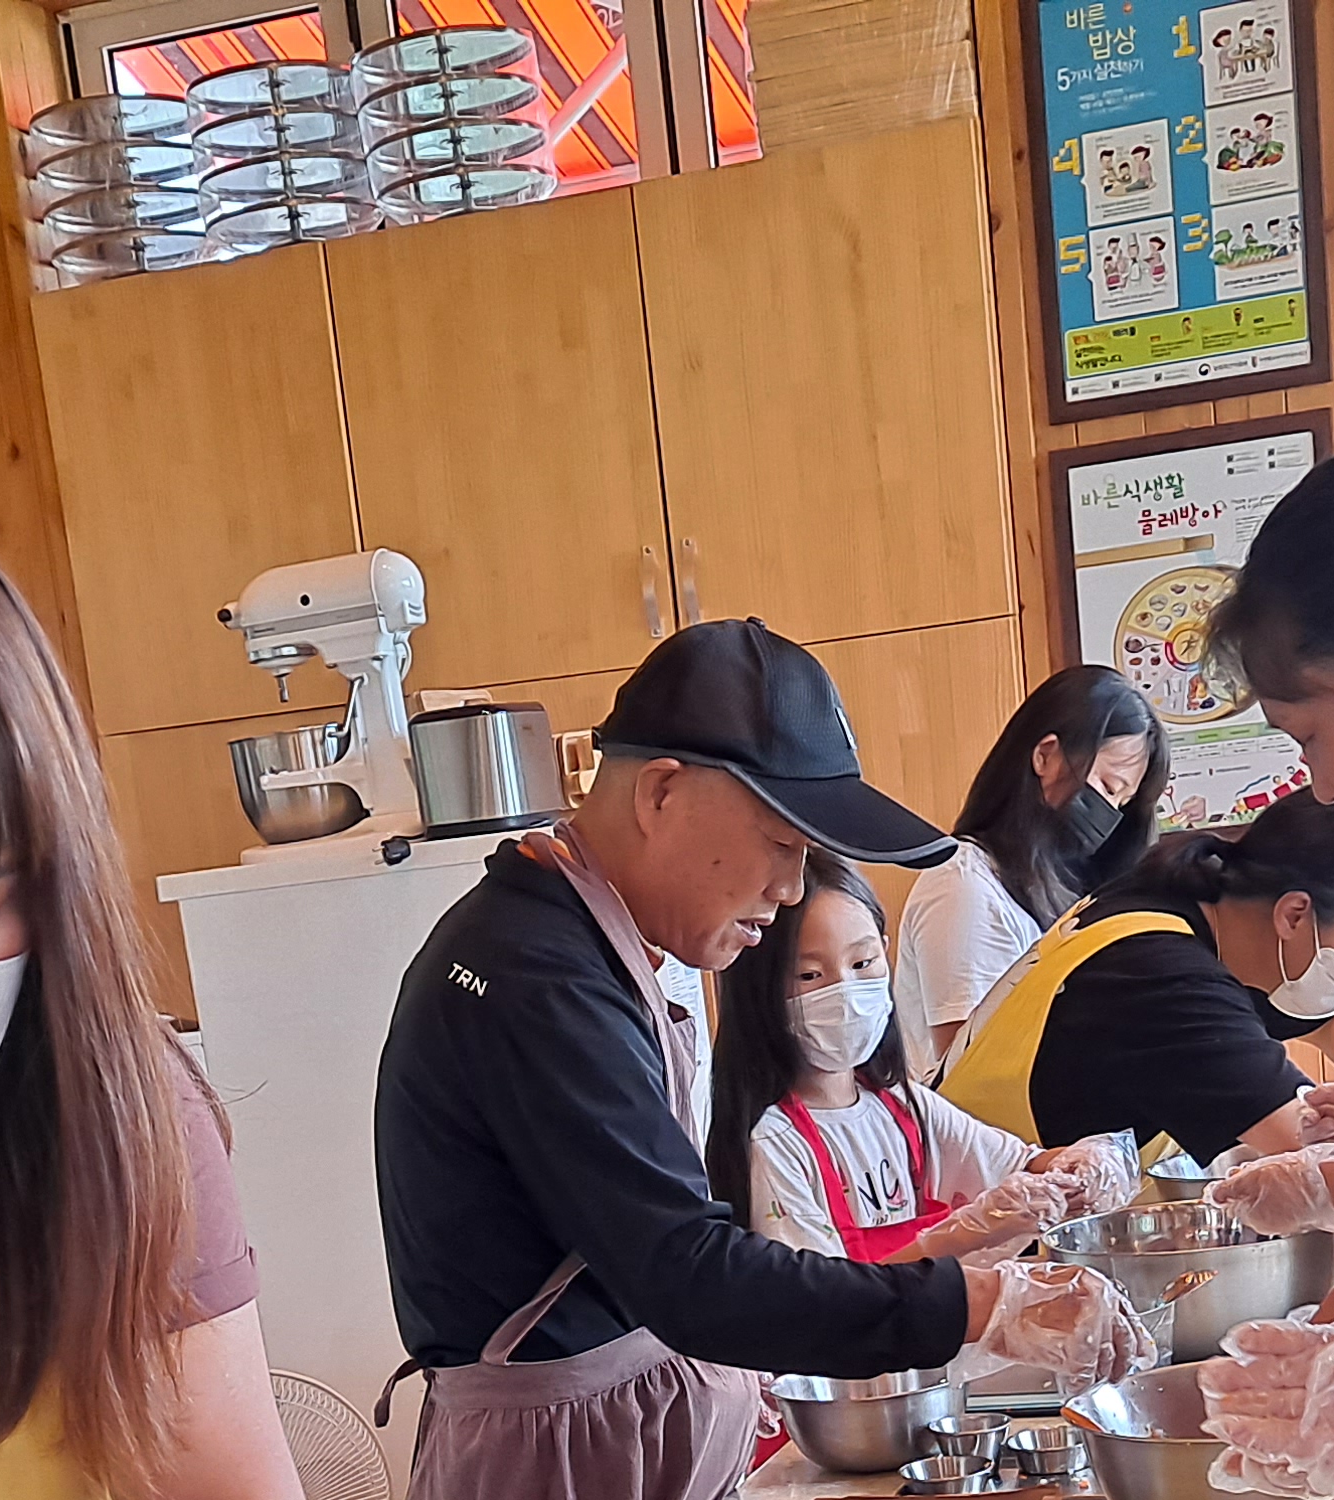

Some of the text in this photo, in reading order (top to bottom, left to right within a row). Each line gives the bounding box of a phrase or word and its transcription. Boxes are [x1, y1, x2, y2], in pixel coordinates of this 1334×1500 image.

[1066, 3, 1107, 30] 바른
[1088, 25, 1136, 60] 밥상
[1172, 15, 1197, 58] 1
[1057, 58, 1144, 91] 5가지 실천하기
[1175, 115, 1204, 155] 2
[1052, 138, 1081, 175] 4
[1181, 213, 1210, 252] 3
[1059, 235, 1087, 274] 5
[447, 962, 488, 997] TRN
